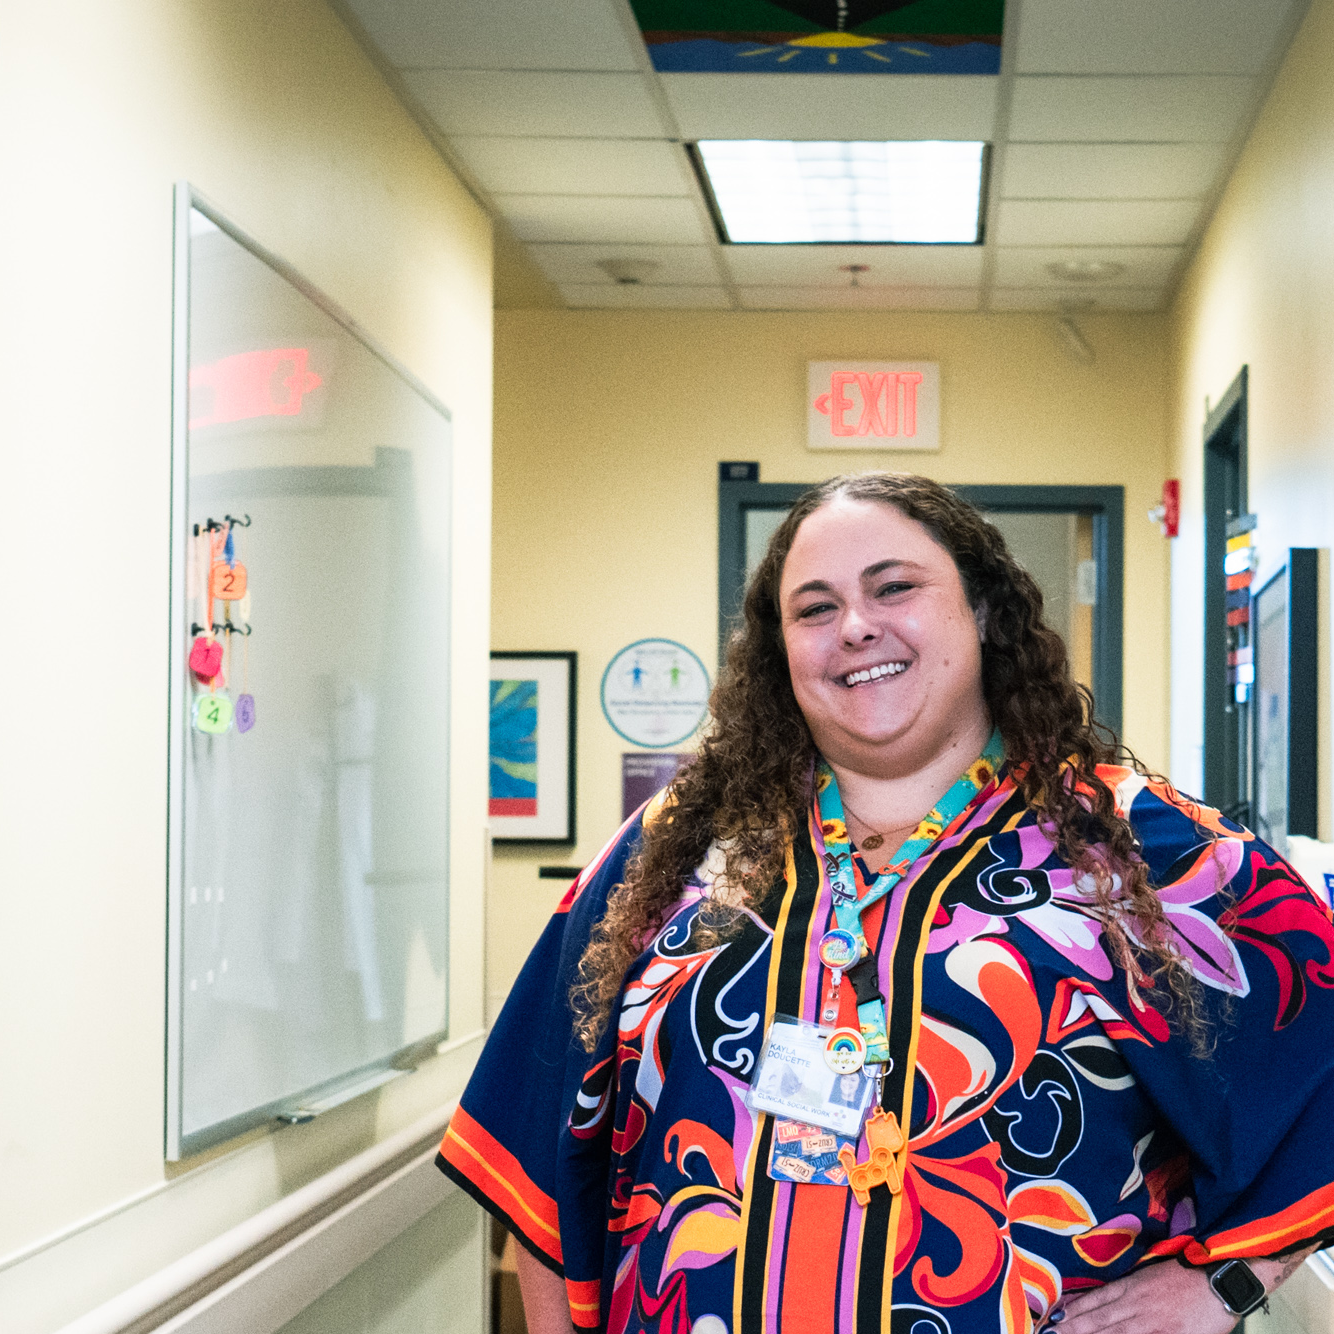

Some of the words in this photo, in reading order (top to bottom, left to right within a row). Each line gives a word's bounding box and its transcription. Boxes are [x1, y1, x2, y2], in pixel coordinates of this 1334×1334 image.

[831, 370, 923, 438] EXIT
[223, 573, 235, 592] 2
[207, 707, 219, 724] 4
[770, 1042, 796, 1056] KAYLA
[768, 1050, 811, 1068] DOUCETTE
[758, 1092, 785, 1104] CLINICAL
[787, 1101, 809, 1111] SOCIAL
[811, 1108, 830, 1117] WORK
